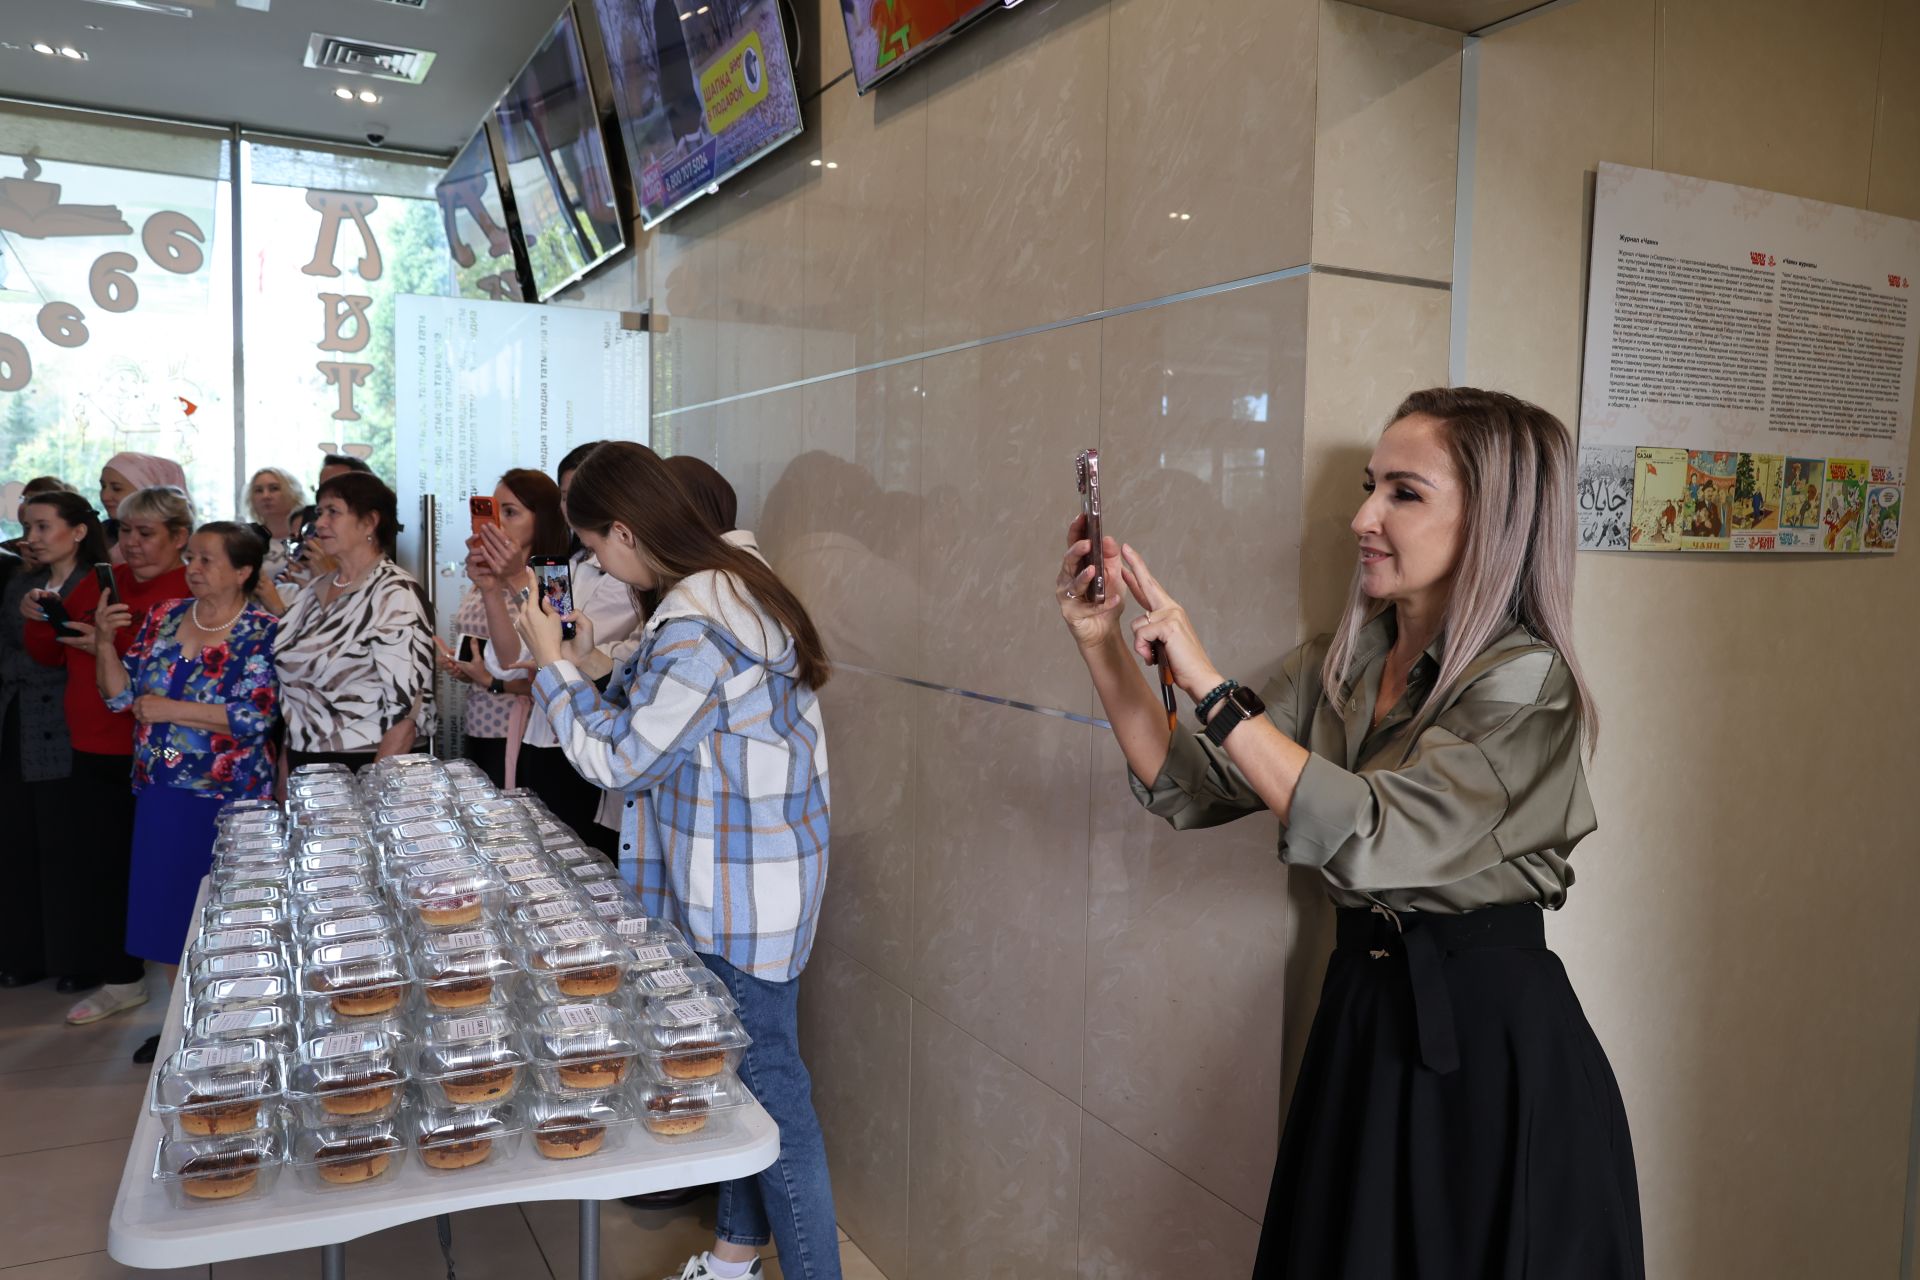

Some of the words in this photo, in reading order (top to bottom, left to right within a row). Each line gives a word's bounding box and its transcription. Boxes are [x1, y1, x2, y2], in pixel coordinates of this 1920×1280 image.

[704, 71, 732, 102] ШАПКА
[712, 85, 744, 118] ПОДАРОК
[669, 171, 682, 189] 800
[692, 152, 708, 173] 5024
[1620, 234, 1640, 244] Журнал
[539, 382, 549, 432] татмедиа
[540, 435, 549, 472] тмедиа
